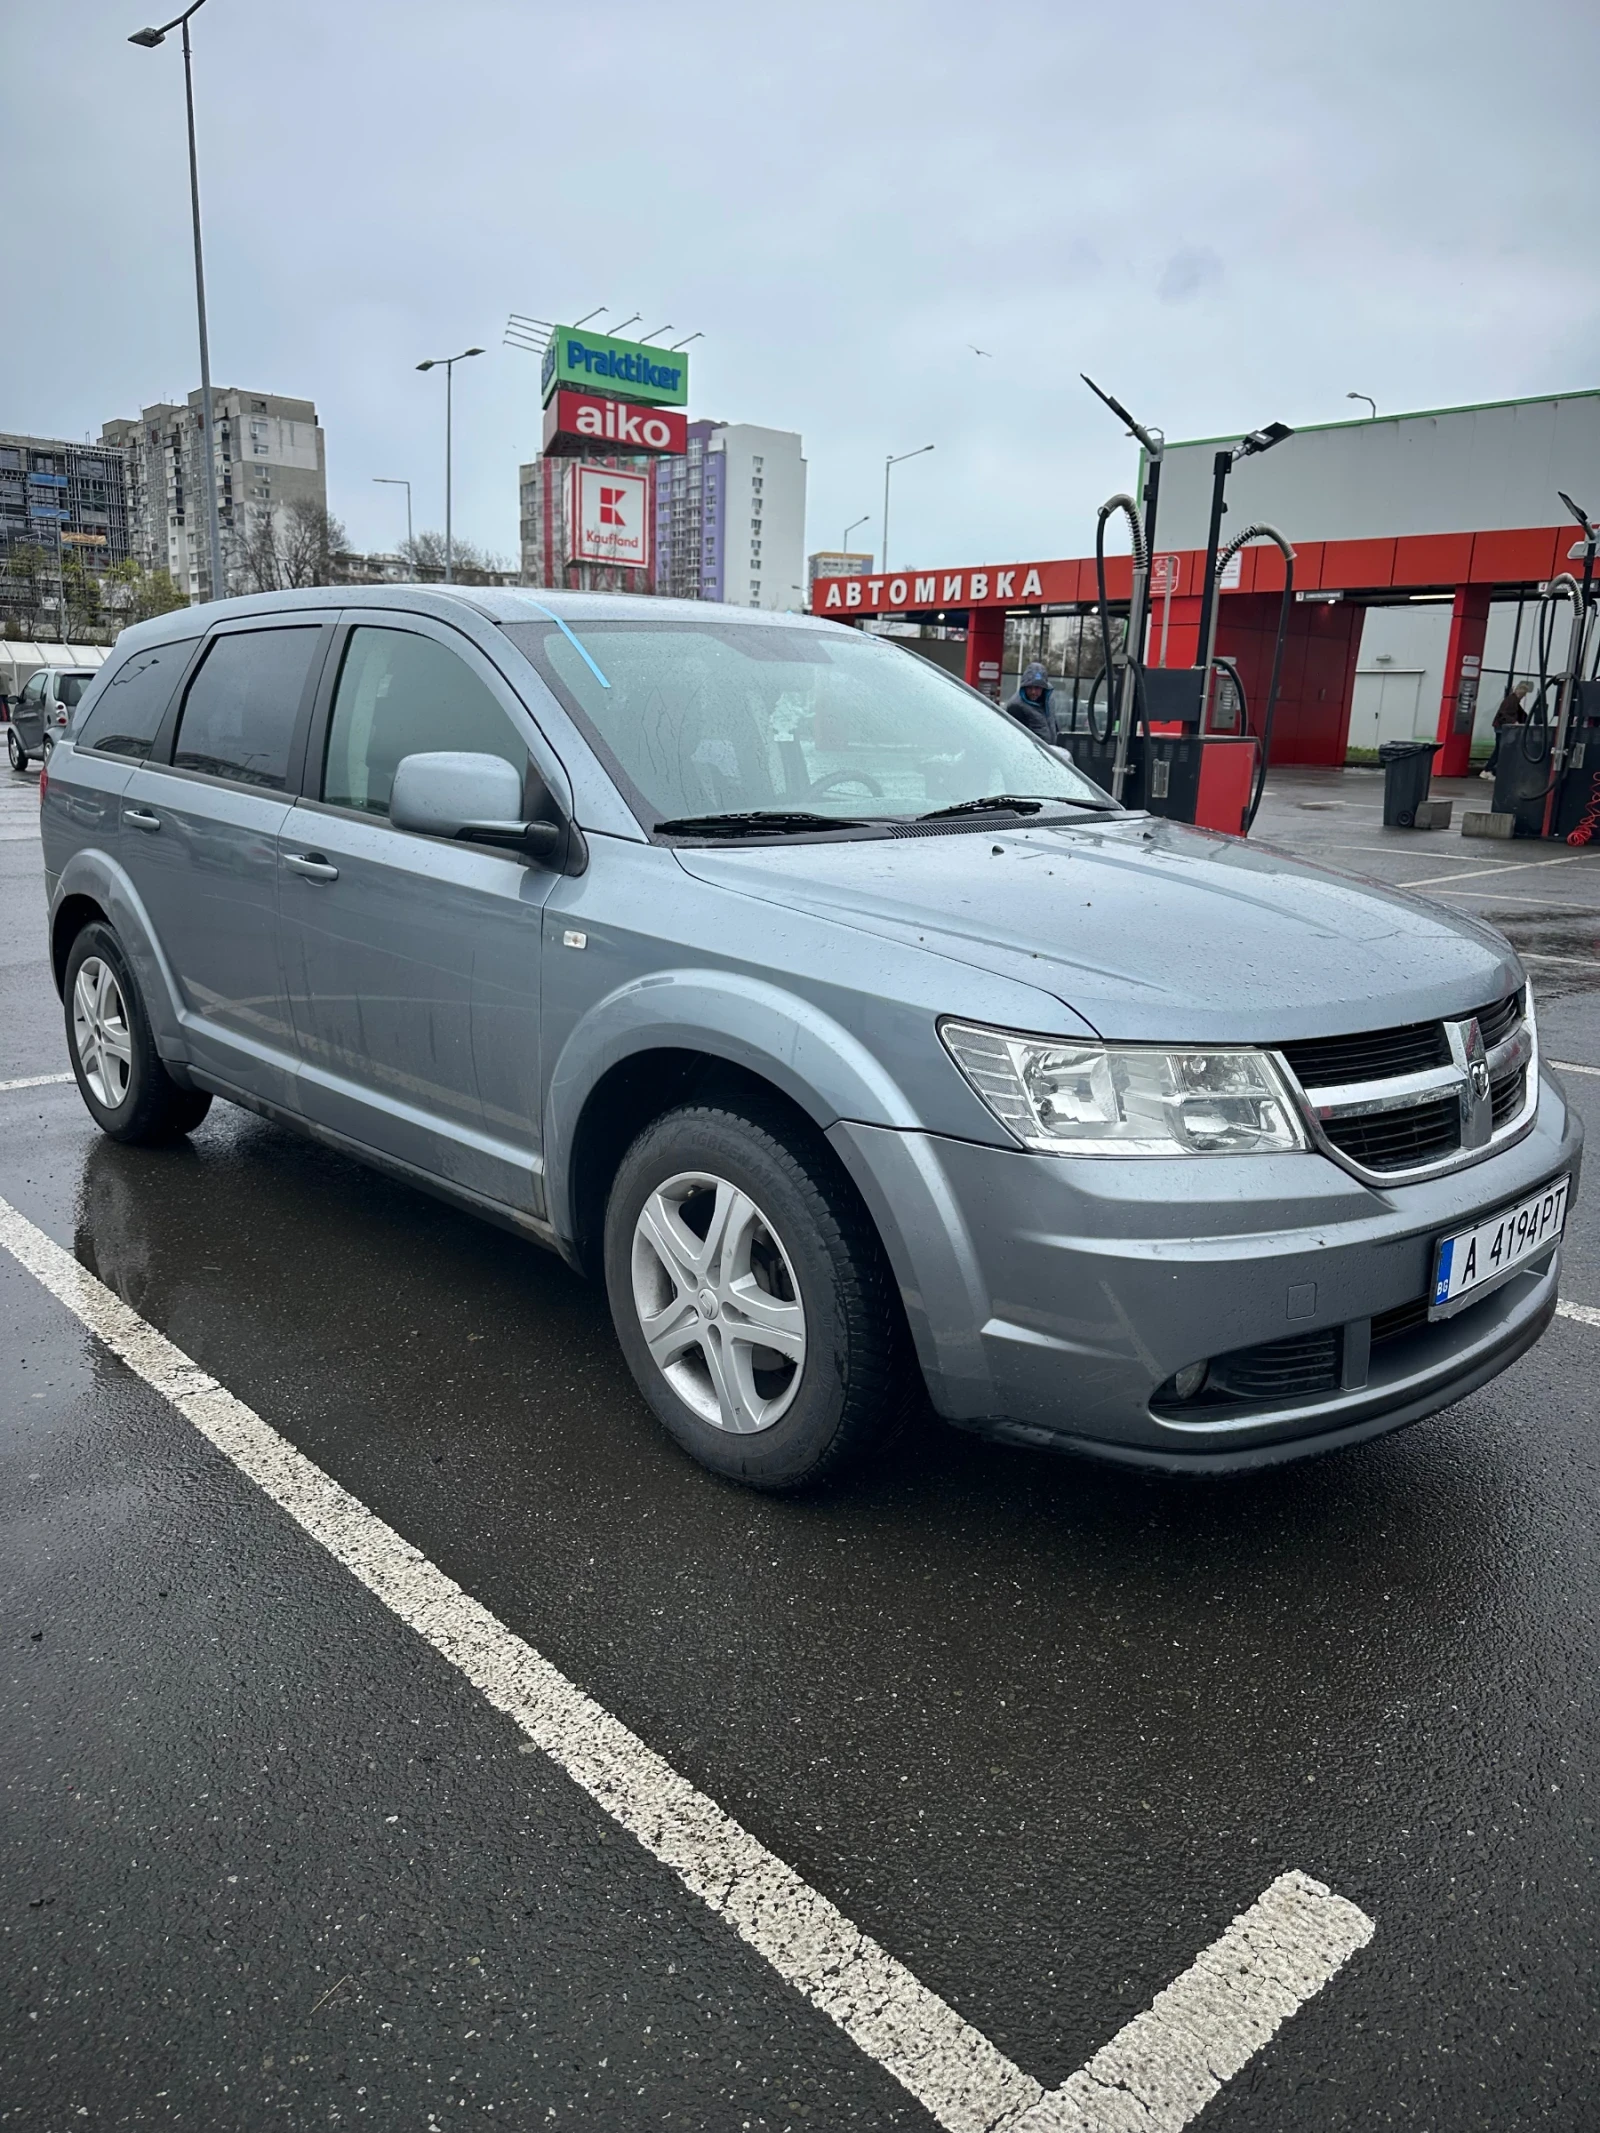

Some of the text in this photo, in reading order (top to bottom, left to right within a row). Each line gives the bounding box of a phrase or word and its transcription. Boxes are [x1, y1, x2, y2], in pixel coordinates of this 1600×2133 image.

[567, 340, 681, 391] Praktiker
[576, 402, 671, 447] aiko
[586, 528, 639, 548] Kaufland
[825, 569, 1043, 607] АВТОМИВКА
[1436, 1279, 1449, 1296] BG
